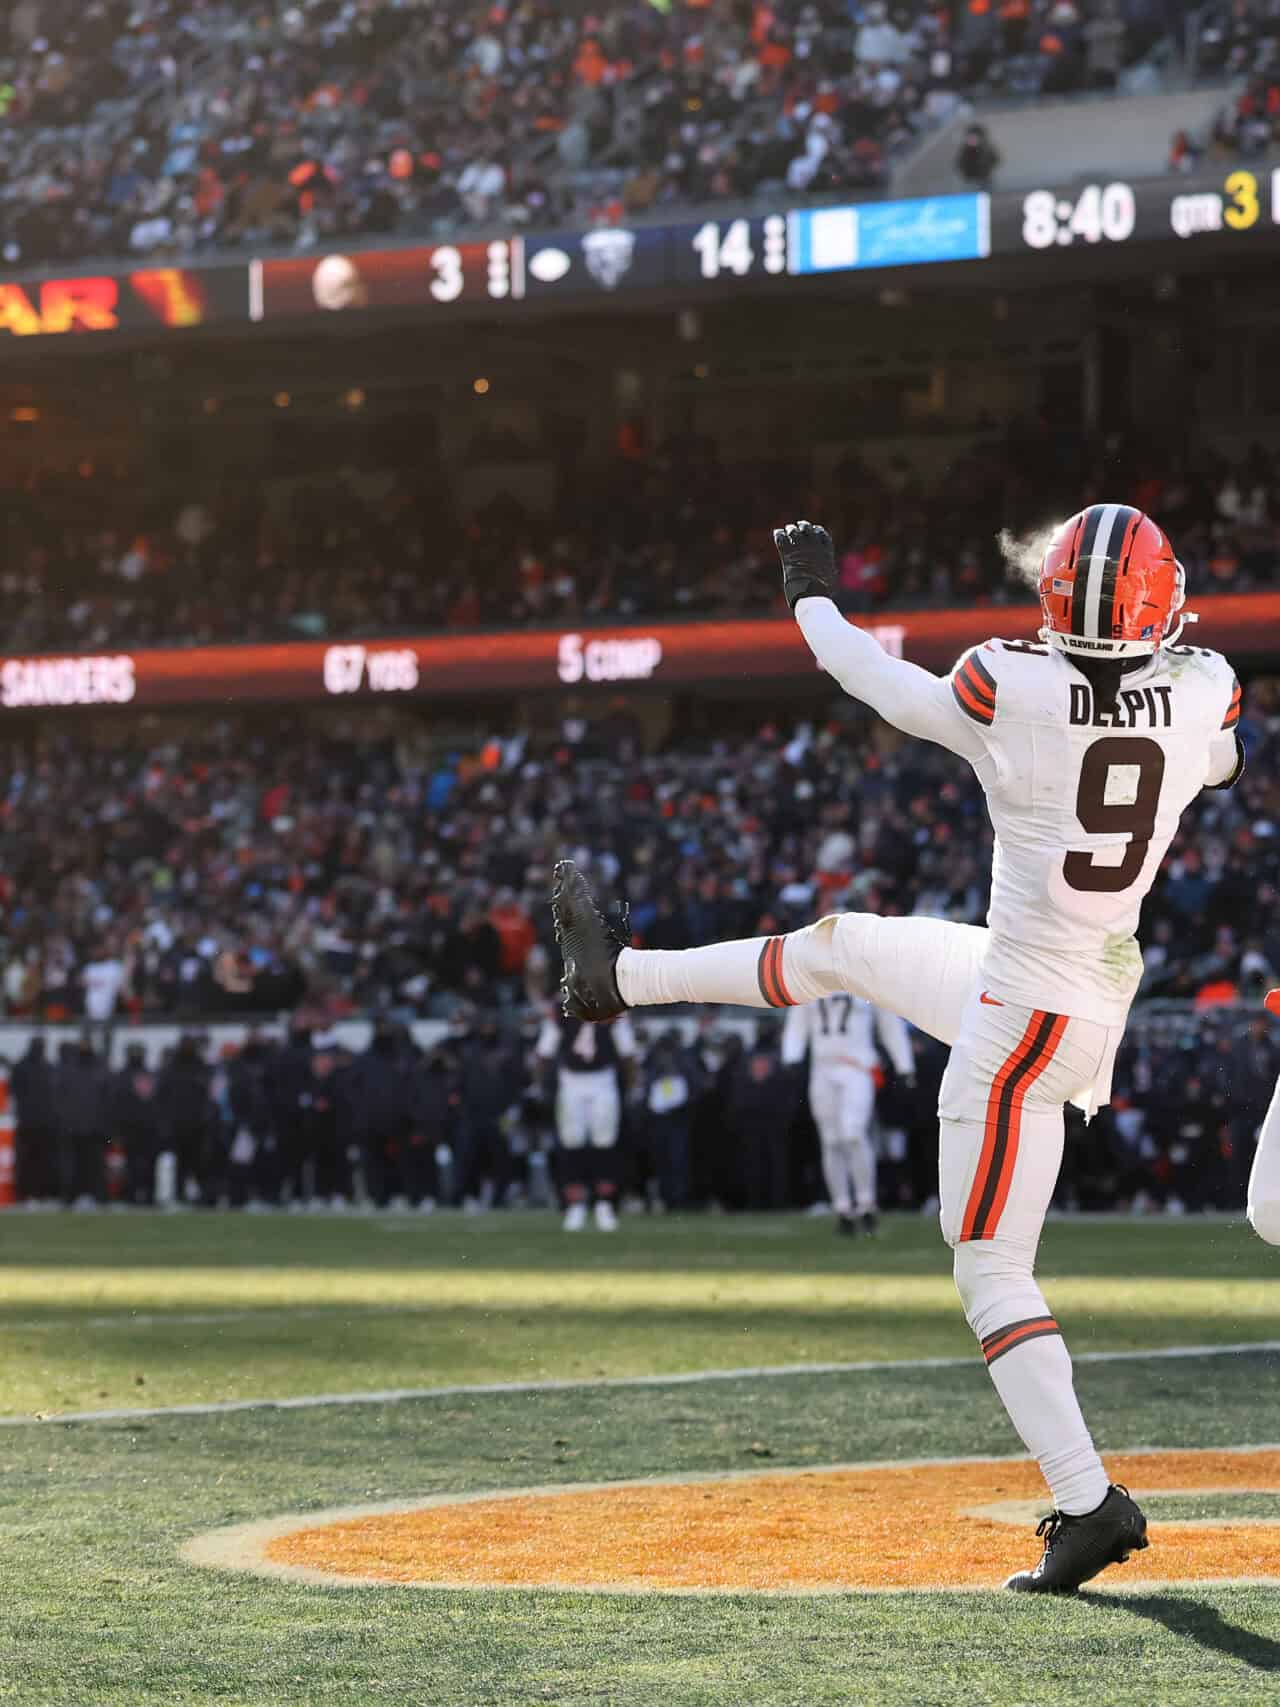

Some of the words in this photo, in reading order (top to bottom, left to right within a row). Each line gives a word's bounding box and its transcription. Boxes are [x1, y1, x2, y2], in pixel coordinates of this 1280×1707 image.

[1022, 182, 1136, 248] 8:40
[1224, 170, 1260, 230] 3
[429, 246, 464, 301] 3
[692, 220, 754, 278] 14
[558, 632, 584, 683] 5
[1069, 638, 1114, 652] CLEVELAND
[1062, 736, 1166, 893] 9
[818, 992, 854, 1037] 17
